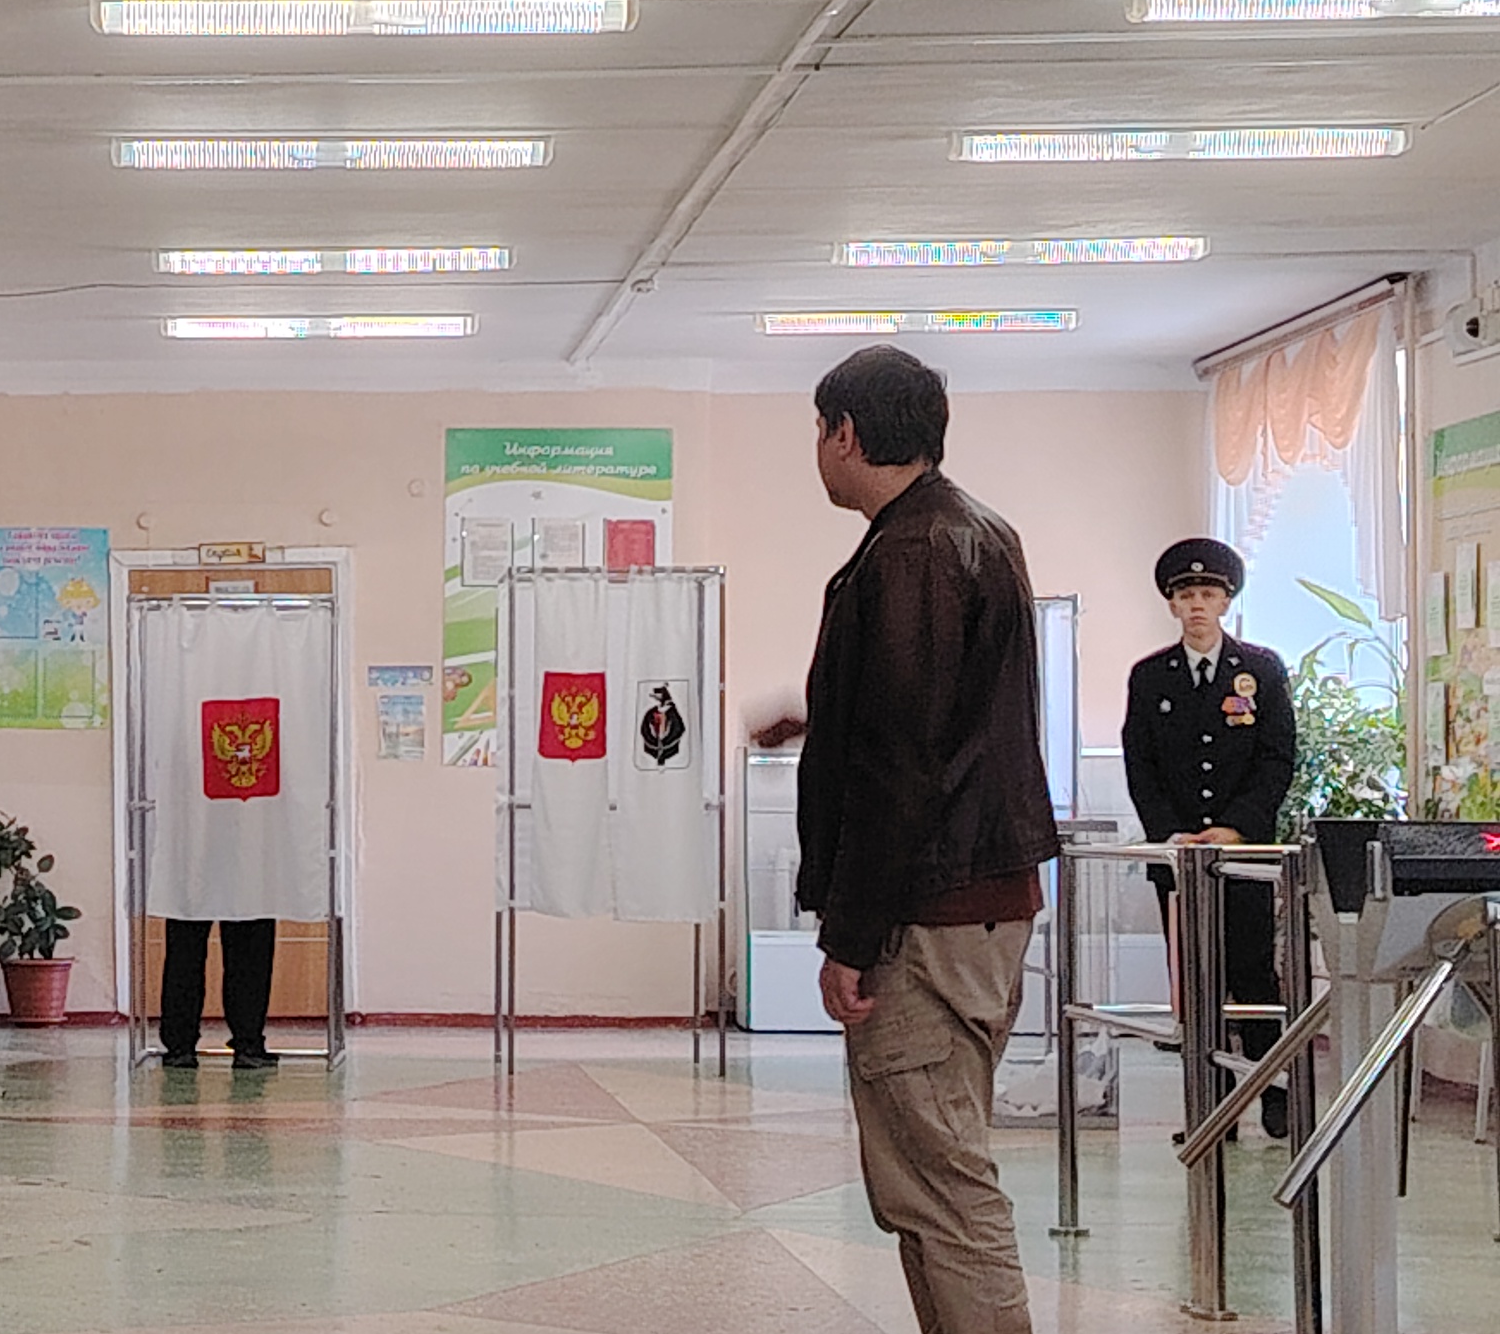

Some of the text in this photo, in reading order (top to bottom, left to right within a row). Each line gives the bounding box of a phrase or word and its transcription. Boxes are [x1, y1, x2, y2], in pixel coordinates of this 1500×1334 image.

[502, 441, 615, 458] Информация
[460, 460, 657, 477] по учебной литературе
